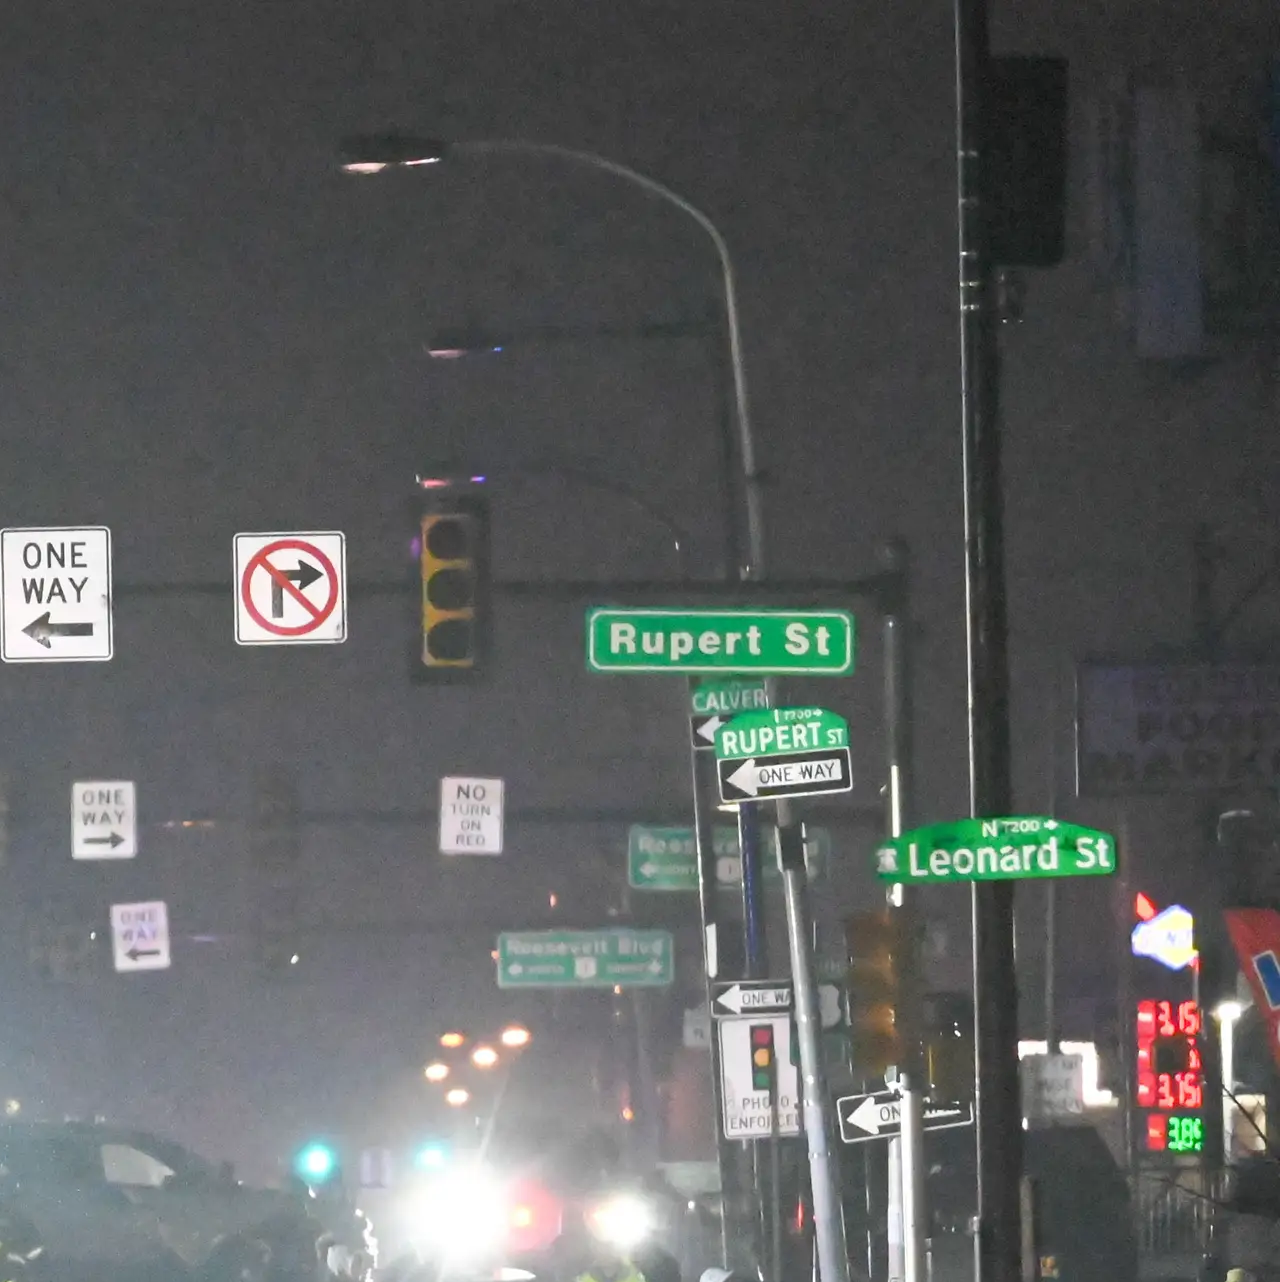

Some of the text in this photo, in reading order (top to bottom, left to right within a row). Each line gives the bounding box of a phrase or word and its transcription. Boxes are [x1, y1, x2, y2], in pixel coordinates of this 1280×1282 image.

[22, 541, 88, 569] ONE
[21, 576, 89, 604] WAY
[610, 622, 831, 661] Rupert St
[693, 688, 766, 712] CALVER
[722, 722, 844, 756] RUPERT ST
[758, 761, 835, 784] ONE WAY
[82, 789, 126, 806] ONE
[457, 783, 486, 801] NO
[81, 810, 126, 827] WAY
[451, 803, 491, 816] TURN
[460, 819, 481, 831] ON
[982, 820, 997, 838] N
[455, 833, 485, 846] RED
[908, 836, 1112, 877] Leonard St
[741, 990, 772, 1005] ONE
[741, 1094, 790, 1111] PHOO
